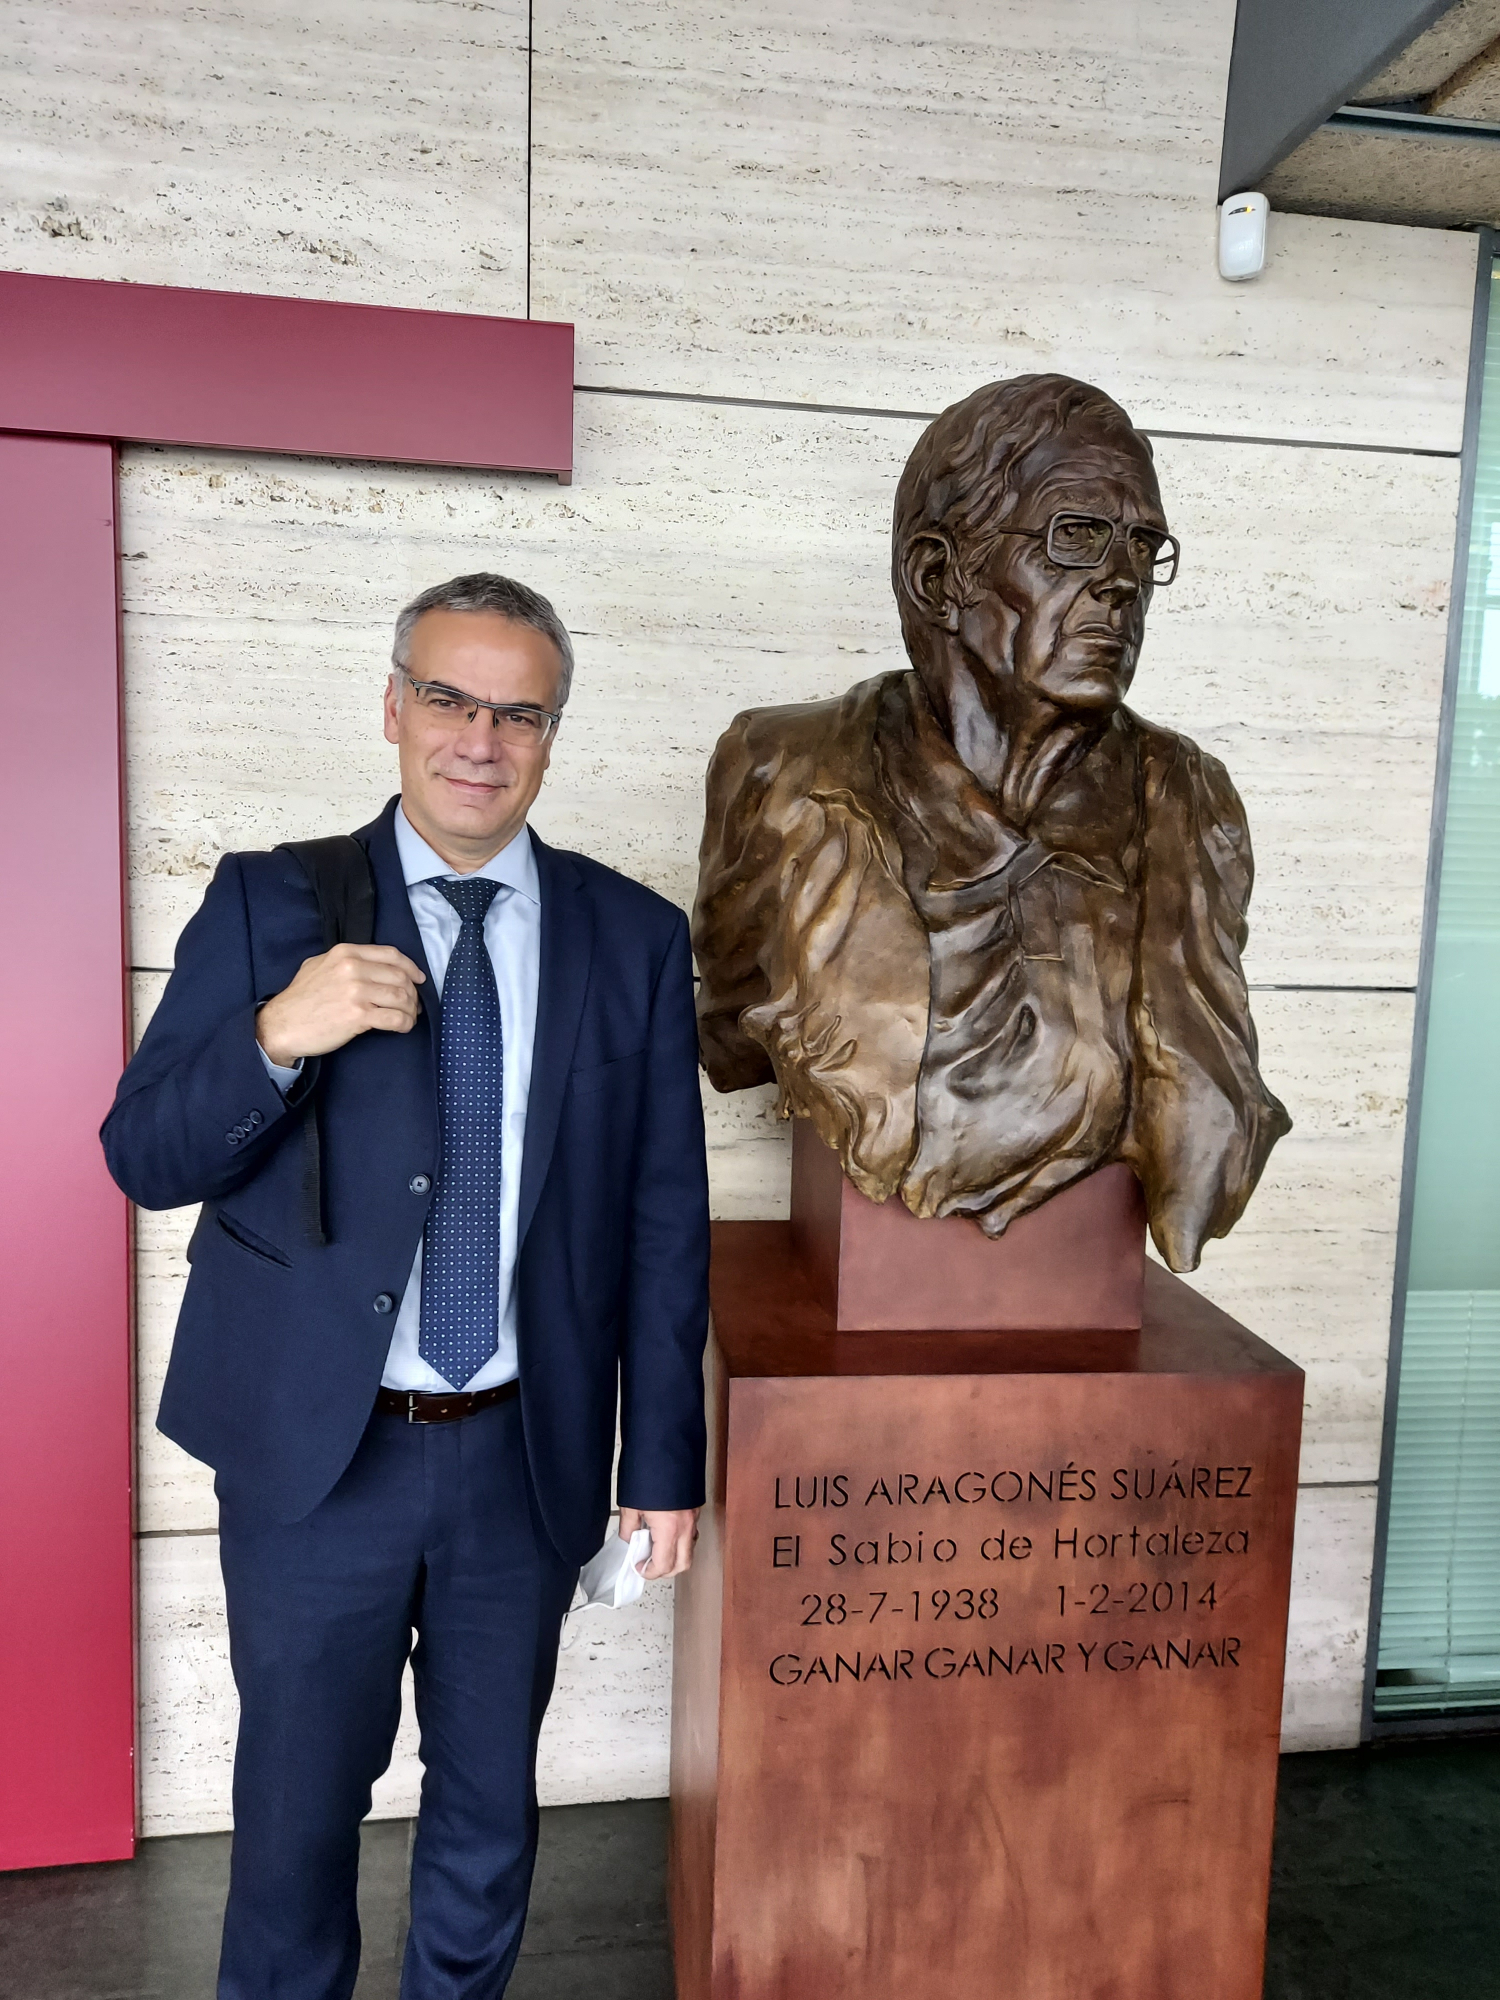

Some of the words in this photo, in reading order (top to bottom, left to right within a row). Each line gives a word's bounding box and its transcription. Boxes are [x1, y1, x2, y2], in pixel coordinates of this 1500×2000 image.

[775, 1475, 848, 1509] LUIS
[865, 1462, 1096, 1506] ARAGONÉS
[1111, 1460, 1251, 1500] SUÁREZ
[773, 1535, 800, 1567] El
[829, 1531, 957, 1566] Sabio
[981, 1529, 1032, 1561] de
[1055, 1525, 1248, 1559] Hortaleza
[801, 1588, 998, 1626] 28-7-1938
[1058, 1582, 1216, 1616] 1-2-2014
[770, 1650, 914, 1685] GANAR
[925, 1644, 1065, 1679] GANAR
[1078, 1642, 1097, 1672] Y
[1104, 1638, 1240, 1672] GANAR
